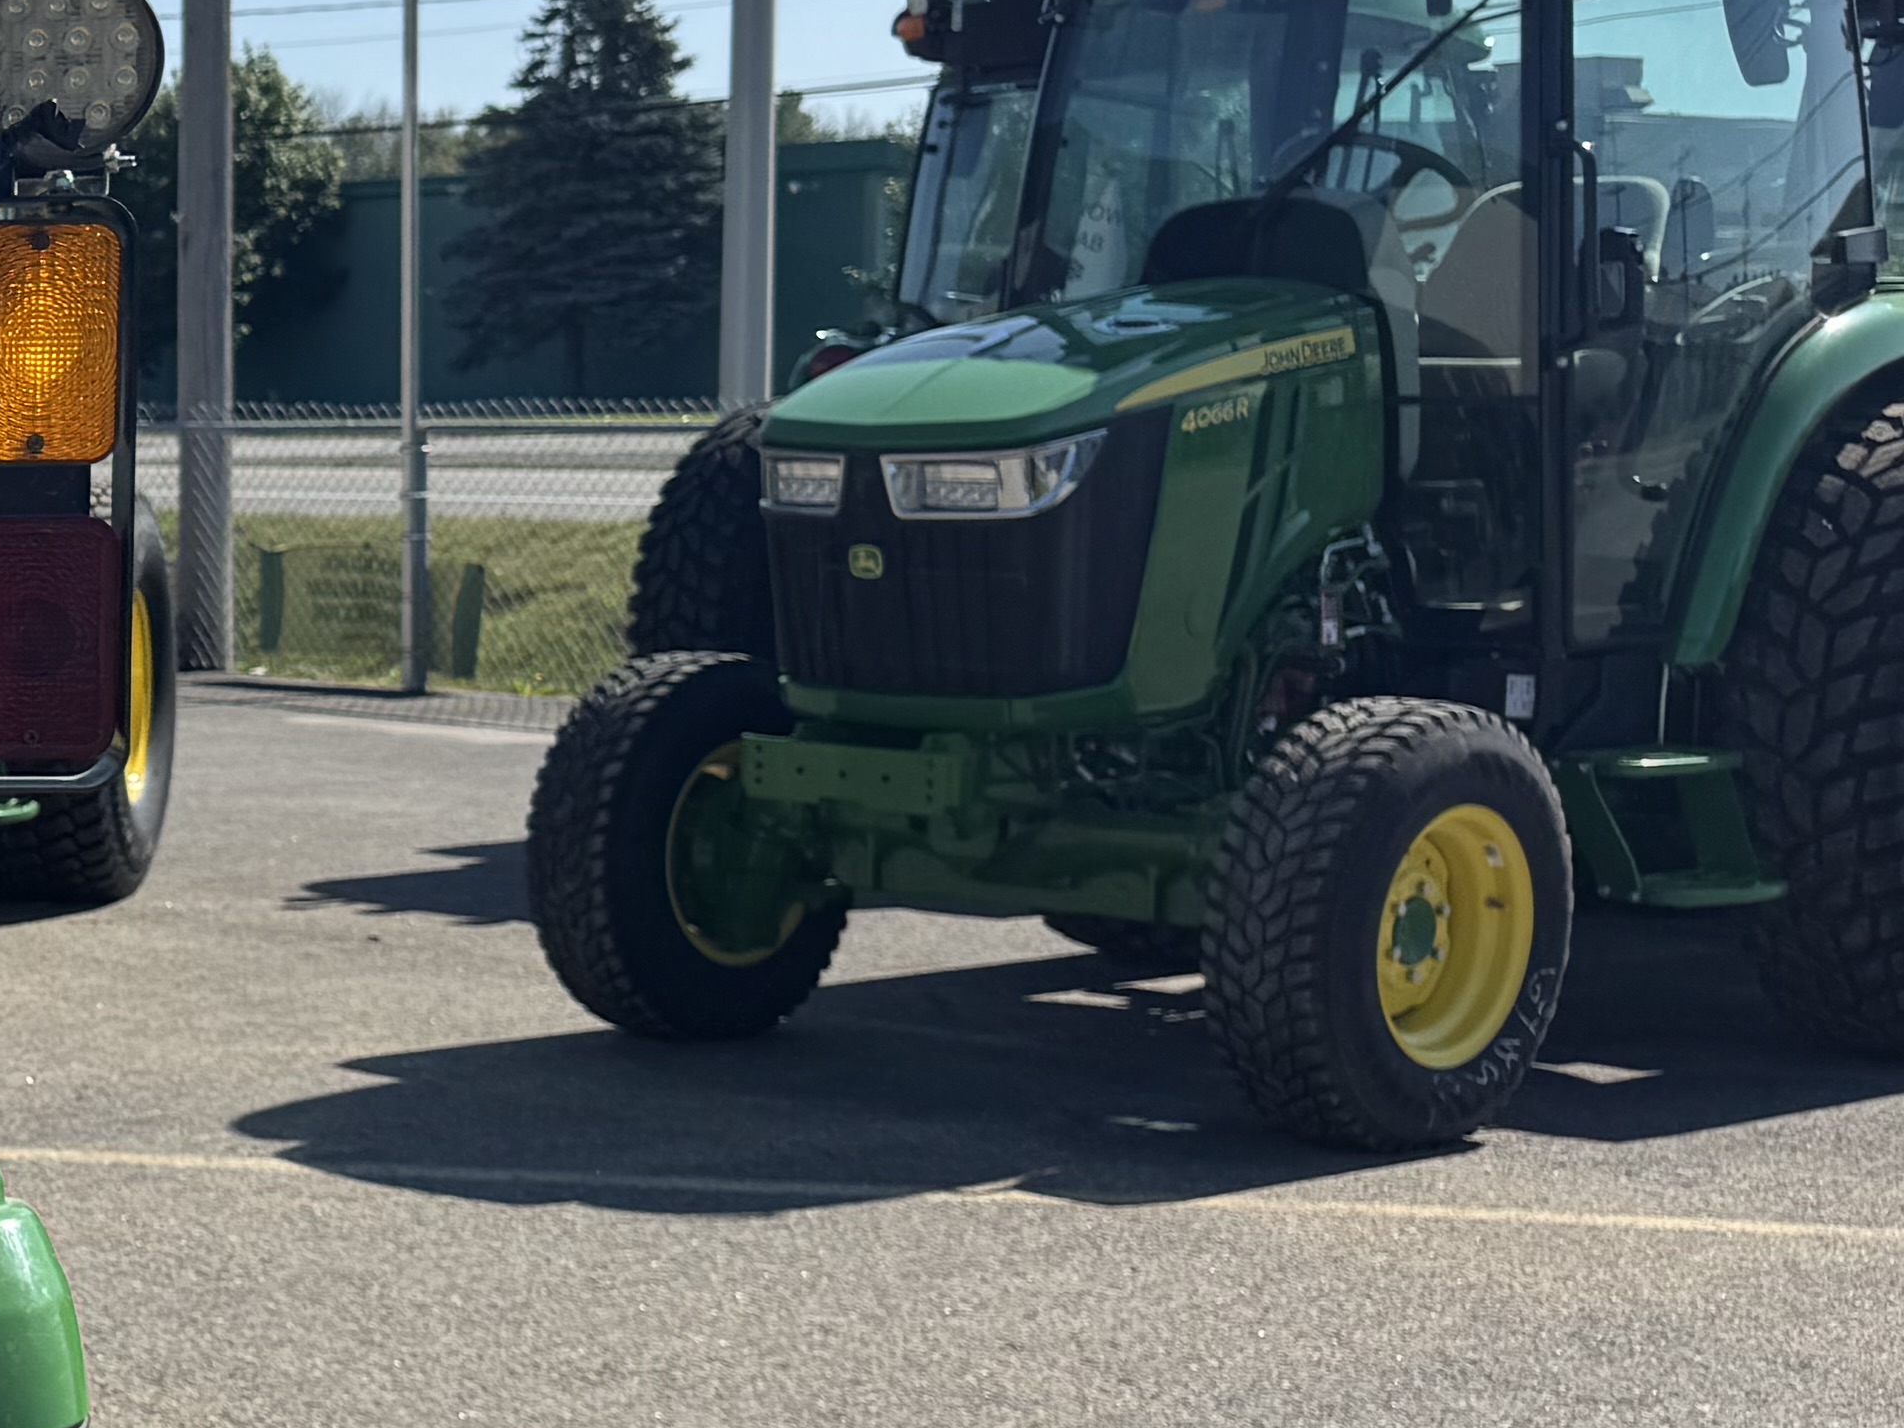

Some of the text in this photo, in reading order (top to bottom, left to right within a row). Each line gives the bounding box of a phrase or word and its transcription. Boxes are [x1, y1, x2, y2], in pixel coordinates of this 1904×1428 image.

[1261, 337, 1346, 374] JOHN DEERE
[1181, 396, 1249, 434] 4066R
